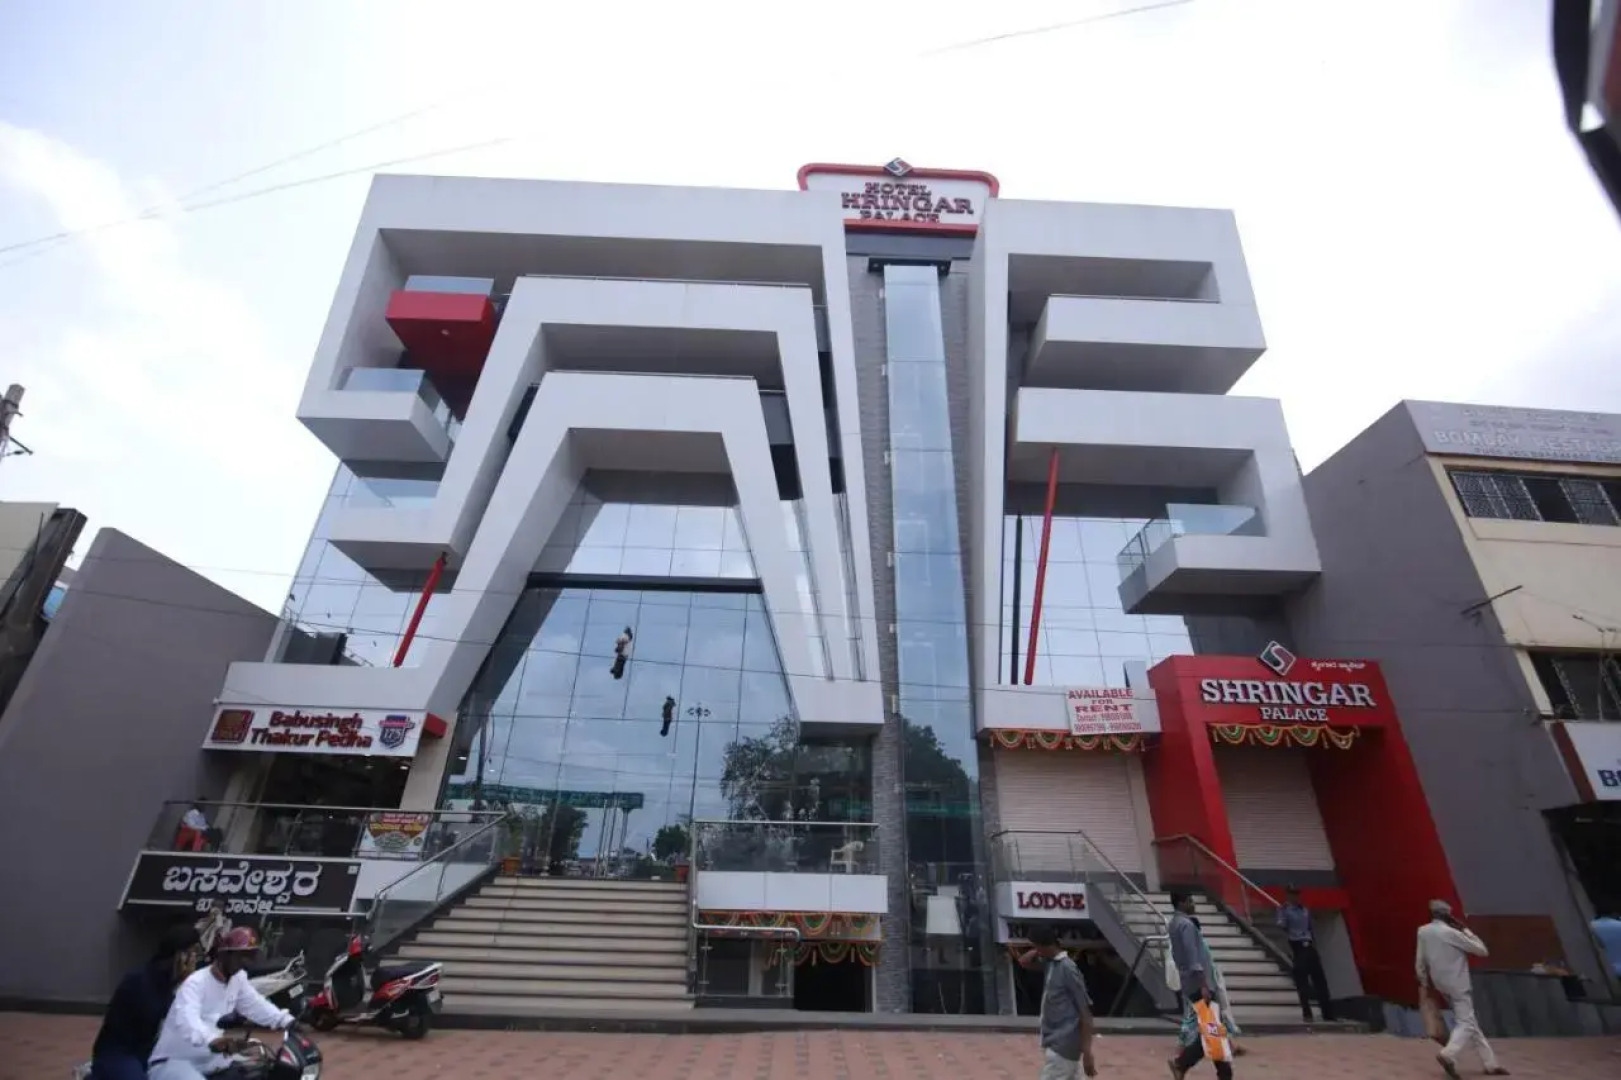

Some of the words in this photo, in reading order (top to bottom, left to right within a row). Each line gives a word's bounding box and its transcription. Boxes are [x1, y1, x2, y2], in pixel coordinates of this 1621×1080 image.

[865, 182, 932, 197] HOTEL
[841, 192, 974, 215] HRINGAR
[1068, 688, 1134, 699] AVAILABLE
[1201, 679, 1377, 707] SHRINGAR
[1075, 704, 1132, 713] RENT
[1260, 706, 1329, 722] PALACE
[269, 710, 364, 733] Babusingh
[251, 728, 315, 747] Thakur
[314, 730, 374, 749] Pedha
[1597, 769, 1621, 787] B
[162, 860, 323, 903] ಬಸವೇಶ್ವರ
[1016, 891, 1085, 910] LODGE
